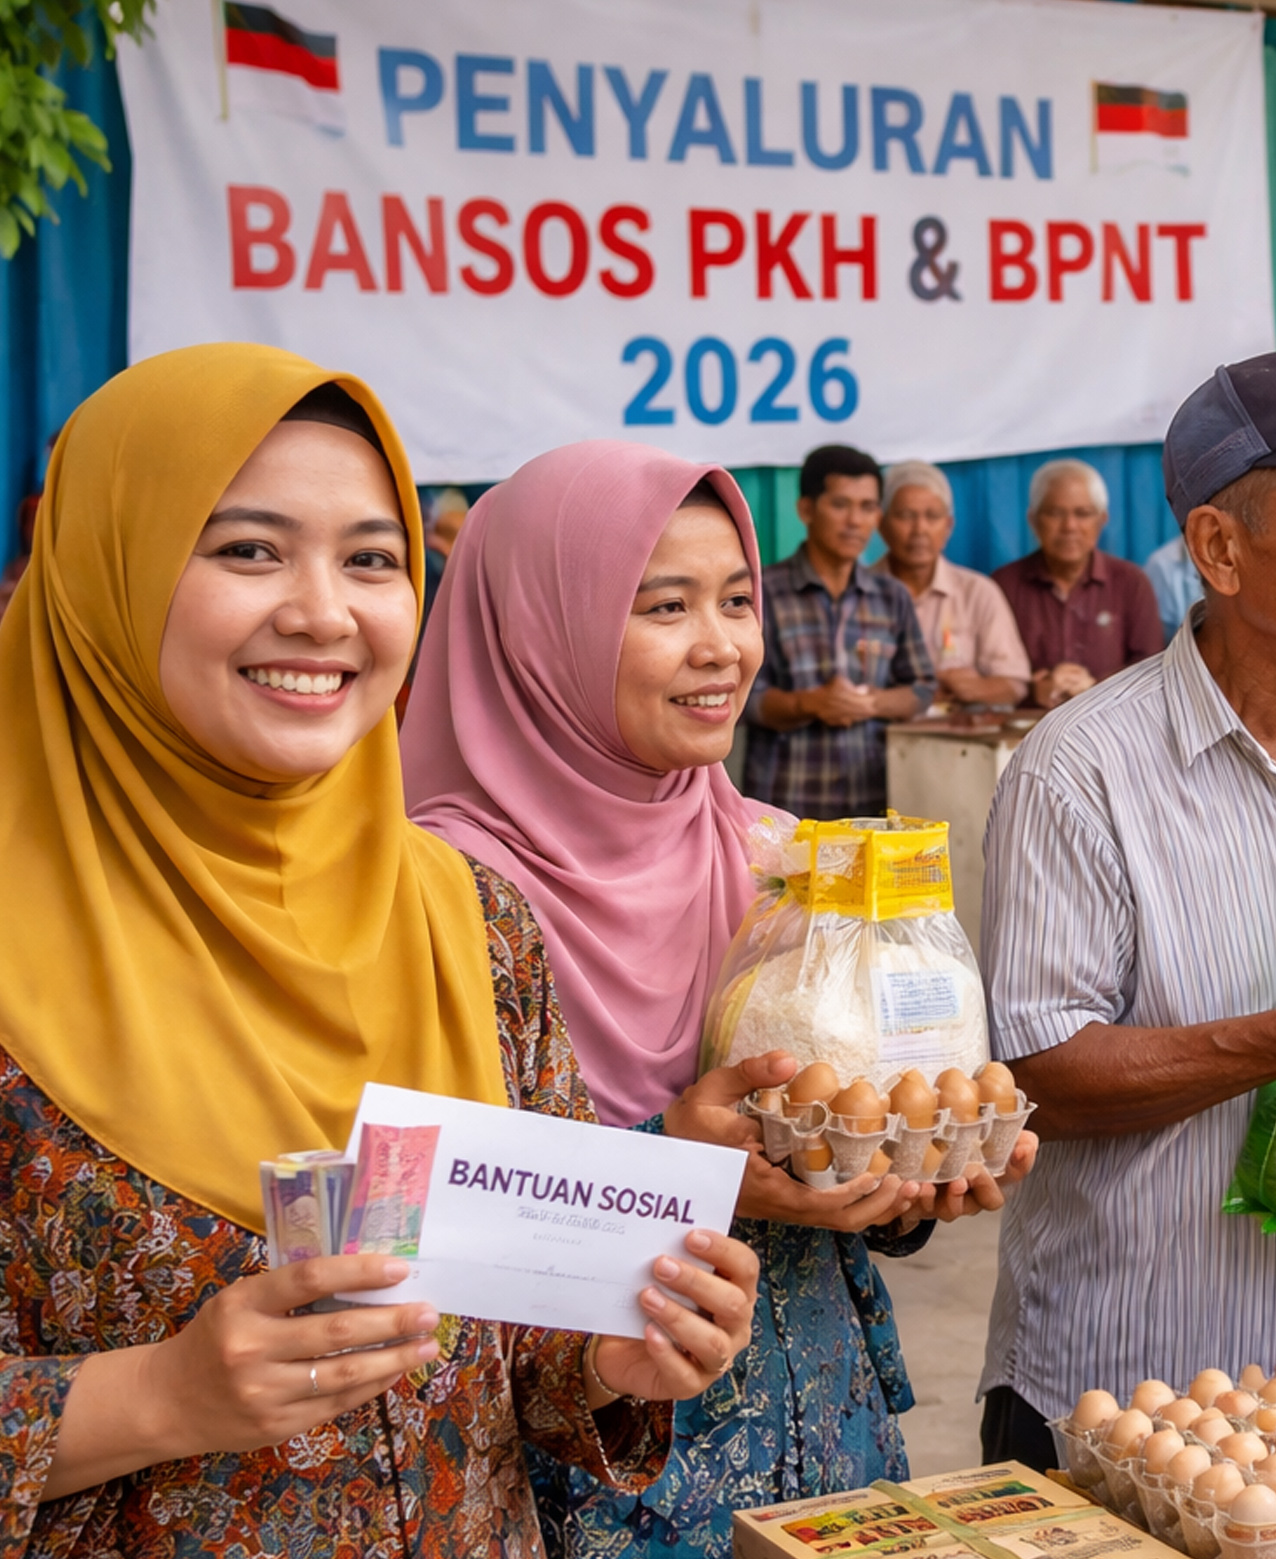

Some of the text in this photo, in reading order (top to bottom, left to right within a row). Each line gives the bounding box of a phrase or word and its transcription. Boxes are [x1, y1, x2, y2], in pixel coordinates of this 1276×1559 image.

[377, 47, 1053, 180] PENYALURAN
[226, 183, 1208, 304] BANSOS PKH & BPNT
[620, 334, 861, 428] 2026
[448, 1158, 594, 1208] BANTUAN
[597, 1185, 695, 1225] SOSIAL
